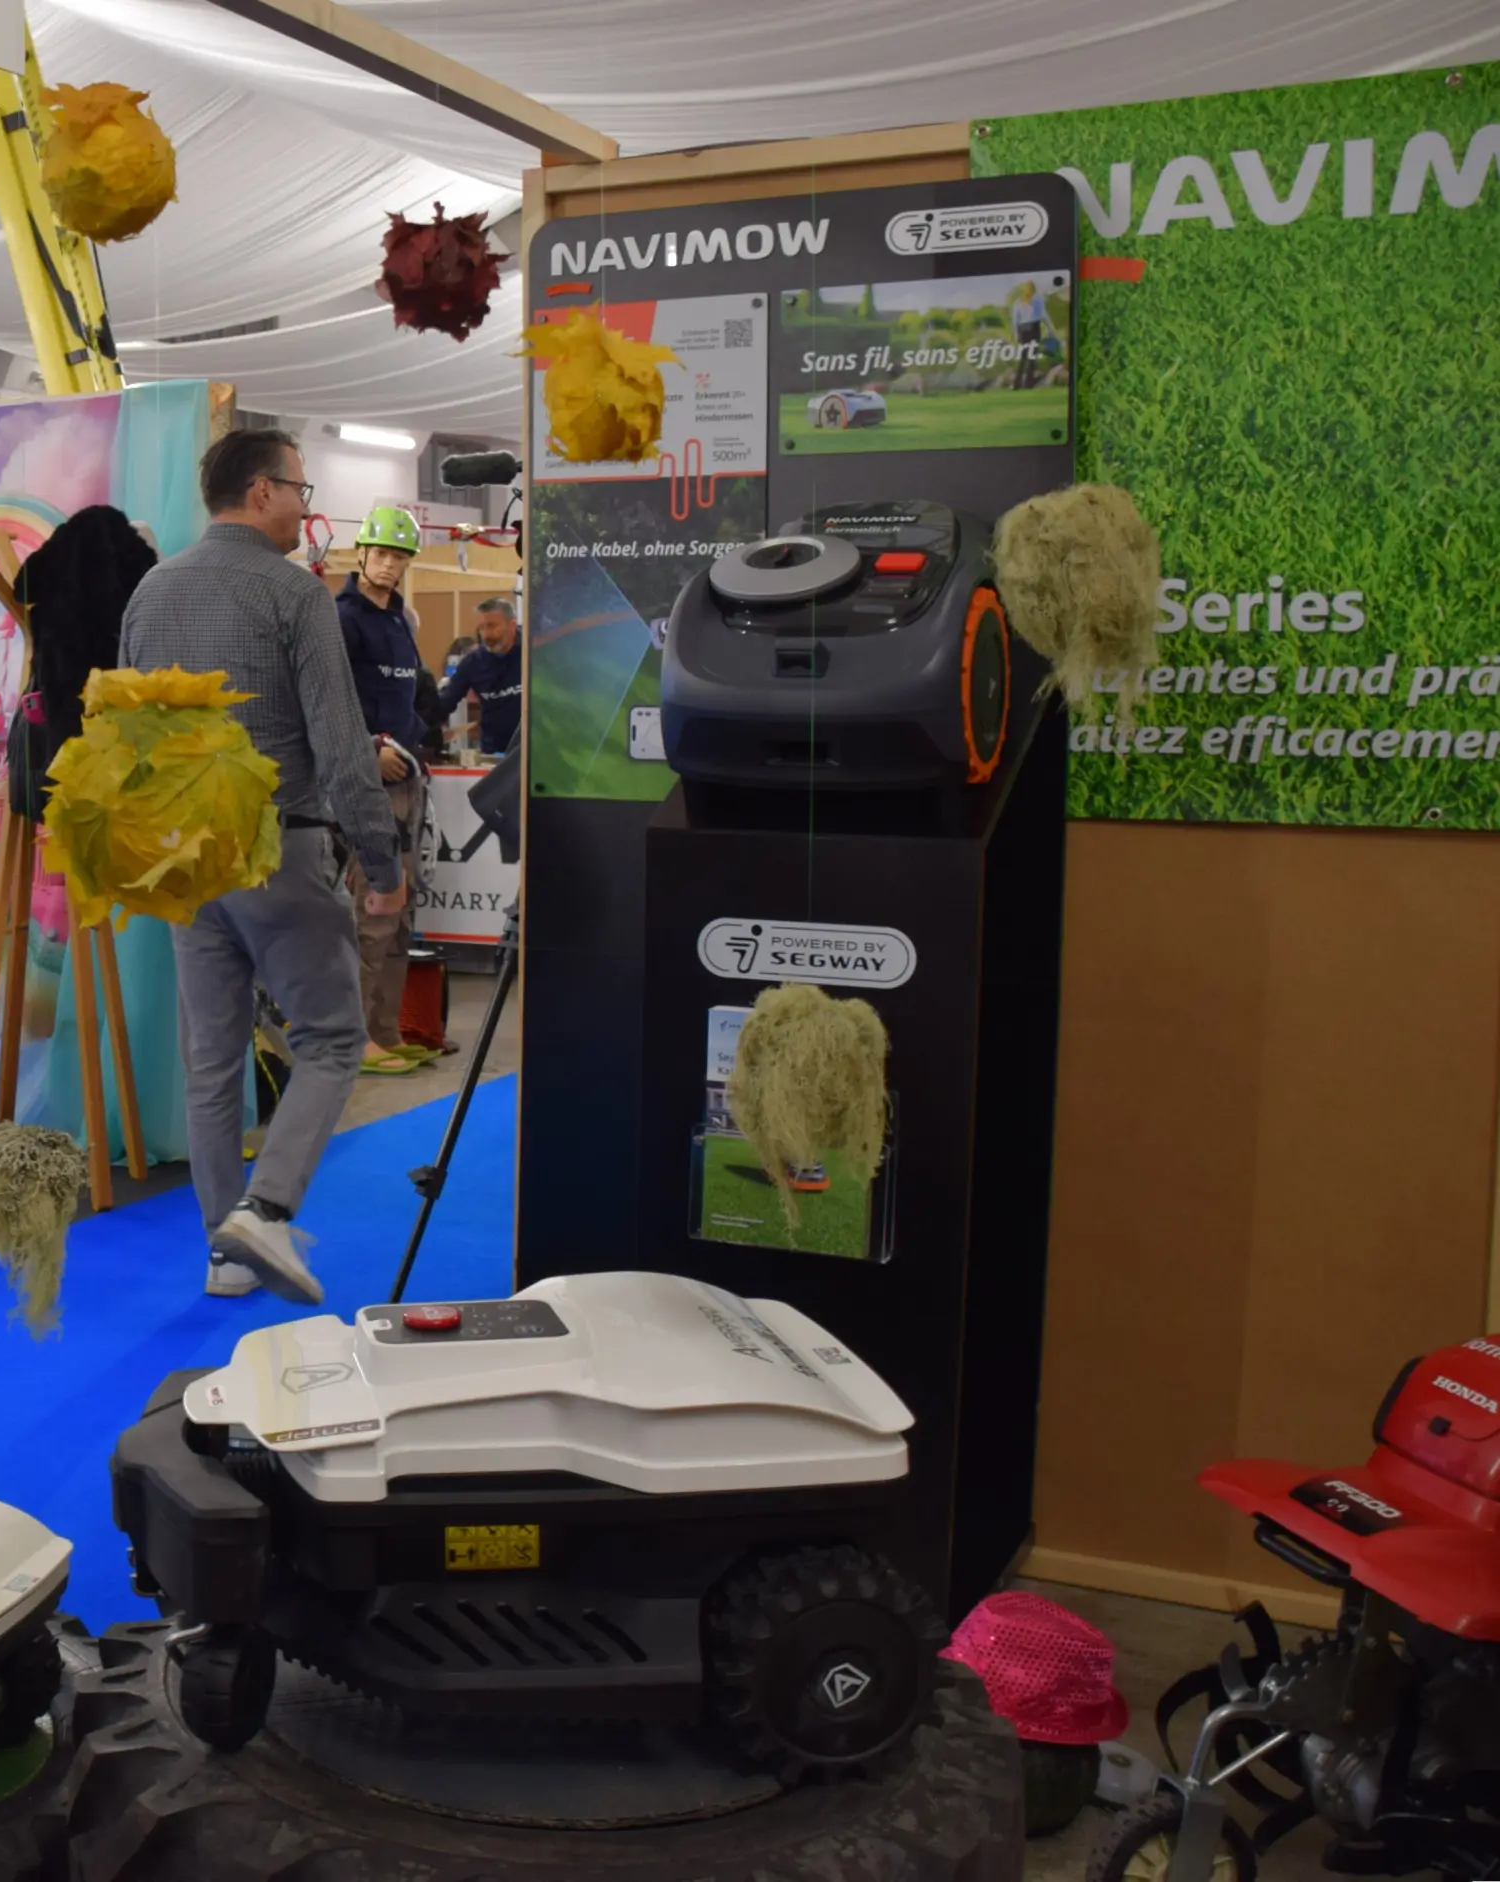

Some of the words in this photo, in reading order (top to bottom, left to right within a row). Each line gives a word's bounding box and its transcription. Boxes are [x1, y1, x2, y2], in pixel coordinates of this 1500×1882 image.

[939, 225, 1026, 243] SEGWAY
[940, 216, 1003, 227] POWERED
[1008, 213, 1027, 223] BY
[550, 218, 830, 277] NAVIMOW
[801, 350, 856, 374] Sans
[864, 346, 894, 373] fil,
[902, 347, 958, 368] sans
[965, 338, 1044, 371] effort.
[546, 543, 587, 558] Ohne
[591, 542, 640, 559] Kabel,
[644, 541, 684, 556] ohne
[1152, 575, 1365, 633] Series
[1296, 654, 1397, 696] und
[771, 937, 858, 951] POWERED
[864, 943, 886, 952] BY
[770, 951, 886, 972] SEGWAY
[1432, 1376, 1498, 1414] HONDA
[275, 1422, 373, 1442] deluxe
[1324, 1480, 1403, 1519] FF500
